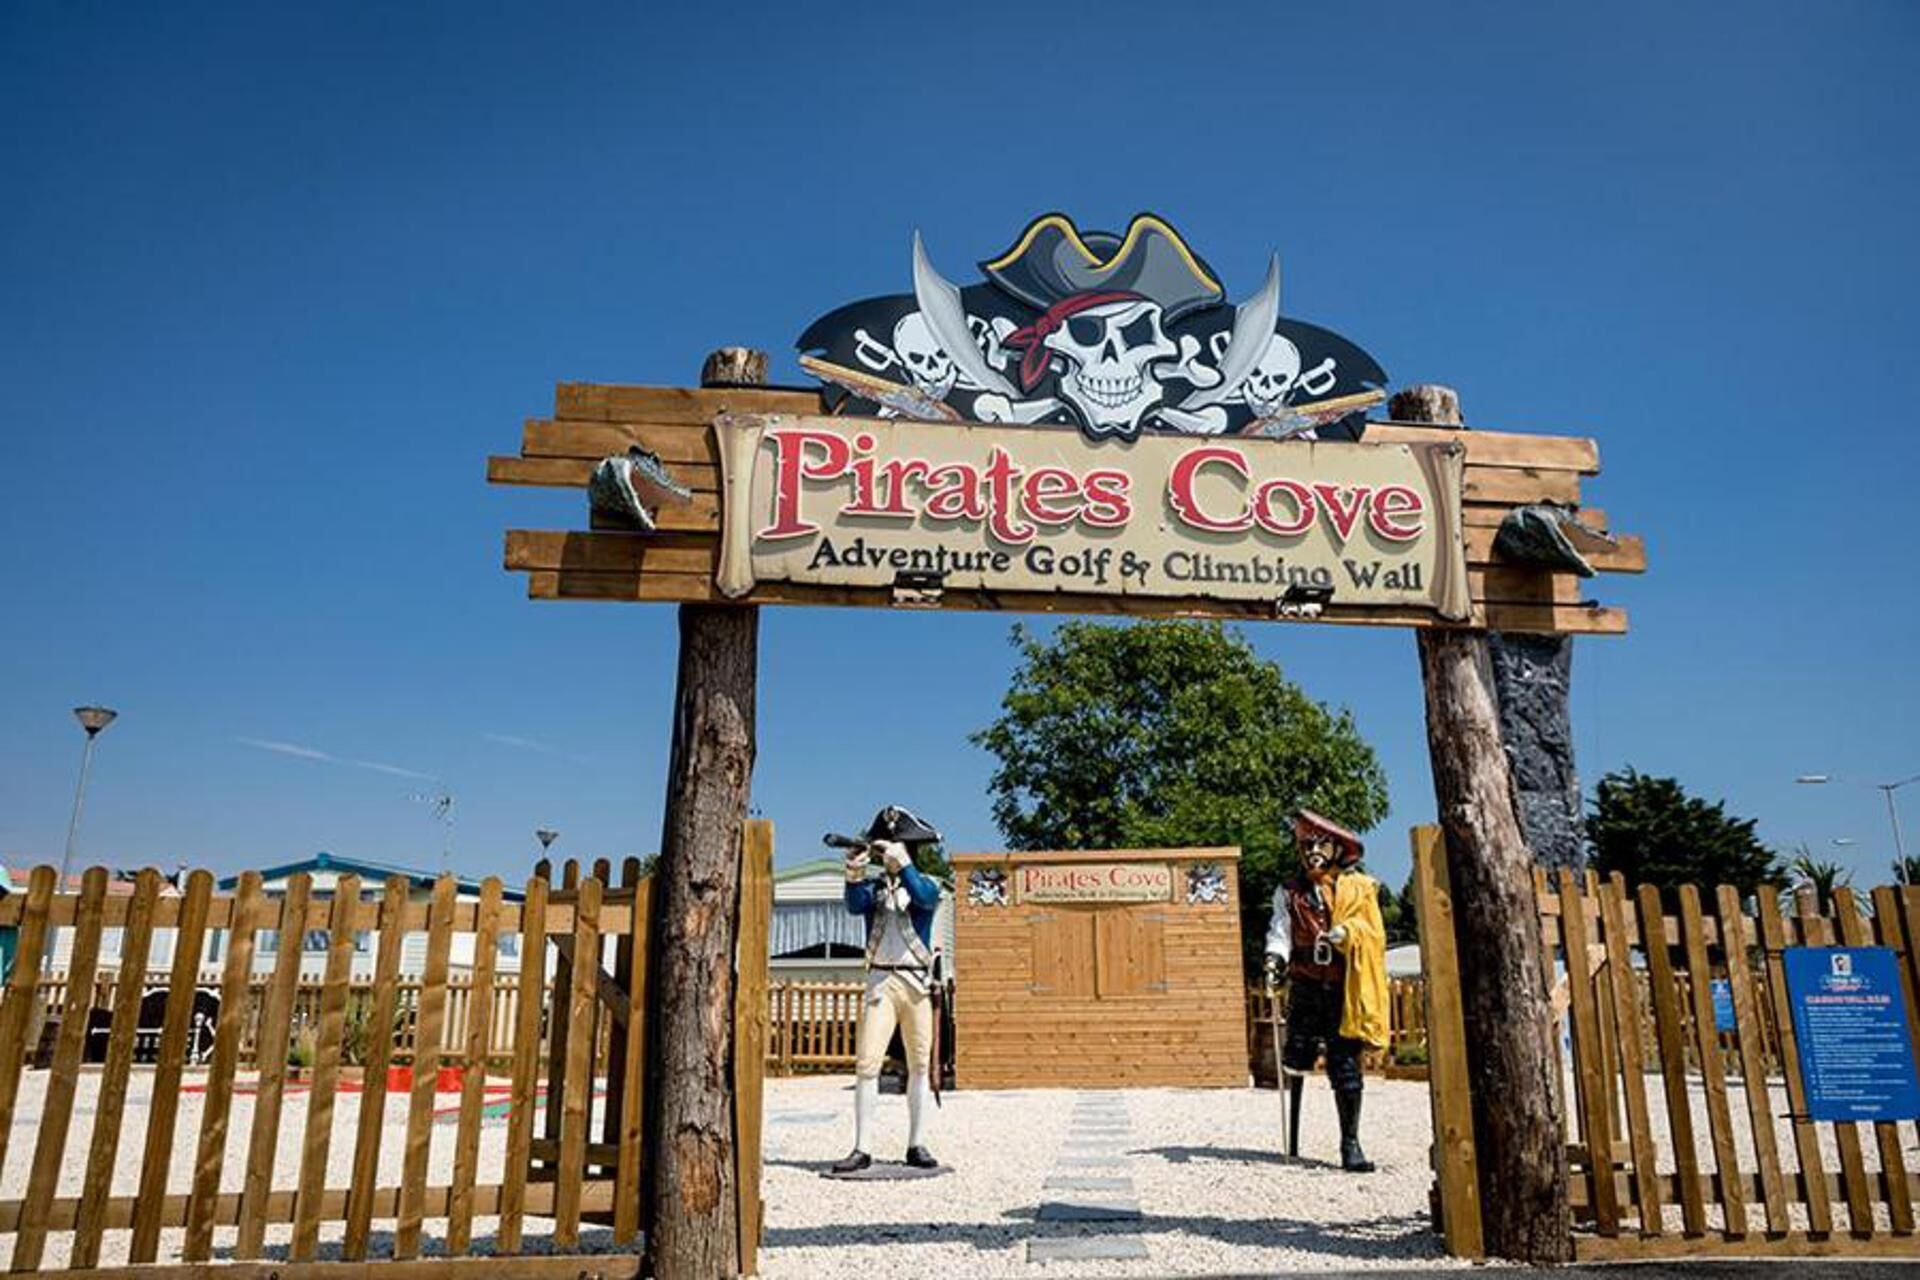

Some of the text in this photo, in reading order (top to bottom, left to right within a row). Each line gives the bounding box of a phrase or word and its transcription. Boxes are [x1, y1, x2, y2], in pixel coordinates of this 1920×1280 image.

[757, 428, 1425, 545] Pirates Cove
[807, 537, 1011, 575] Adventure
[1025, 546, 1112, 585] Golf
[1119, 550, 1150, 585] &
[1343, 559, 1424, 590] Wall
[1024, 867, 1168, 893] Pirates Cove
